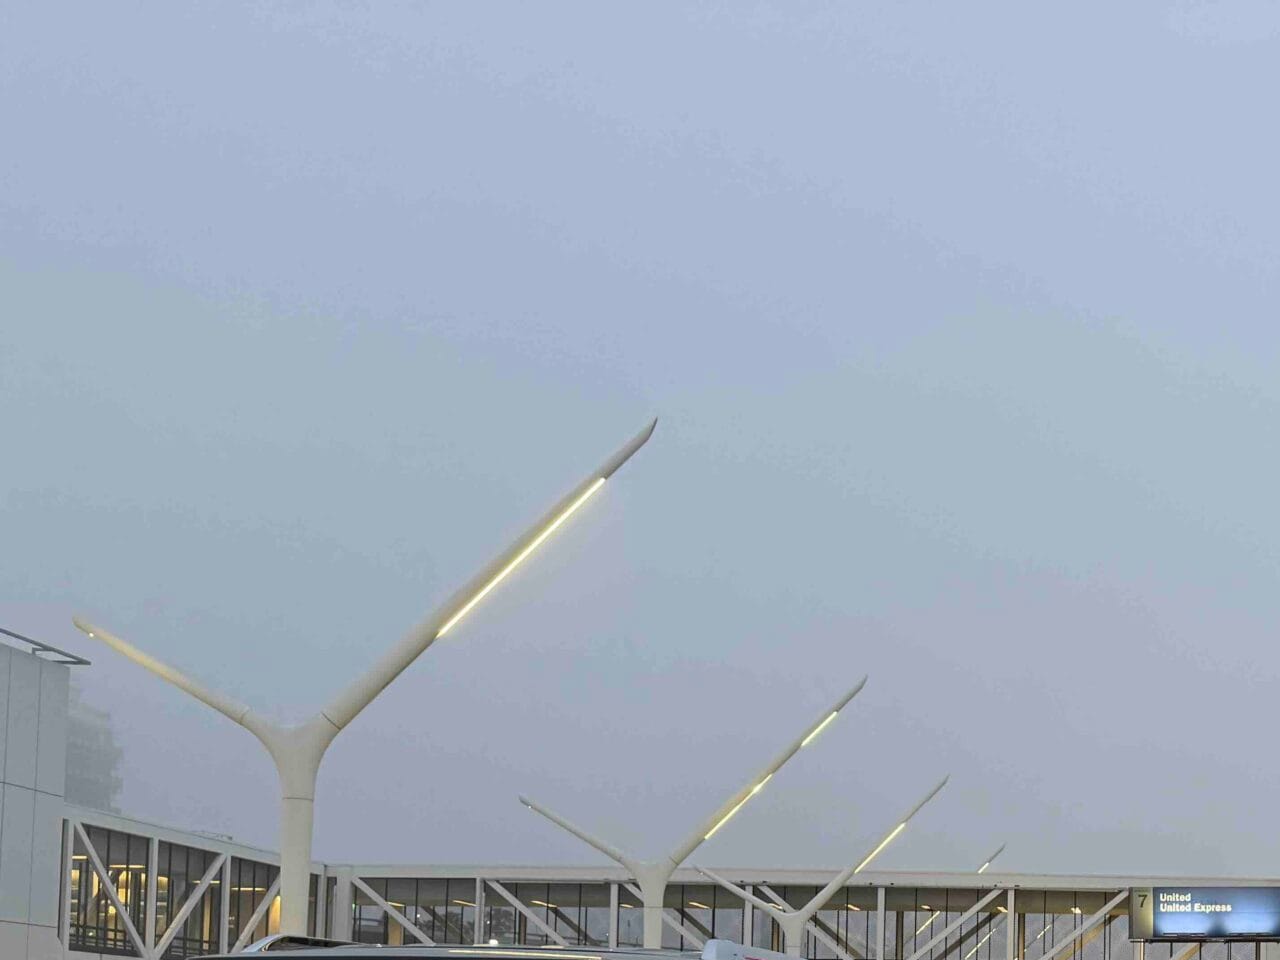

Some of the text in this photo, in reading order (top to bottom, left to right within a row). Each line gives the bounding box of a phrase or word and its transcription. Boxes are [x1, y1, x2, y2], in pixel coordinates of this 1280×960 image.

[1137, 894, 1148, 909] 7
[1159, 893, 1192, 902] United
[1159, 903, 1233, 914] United Express
